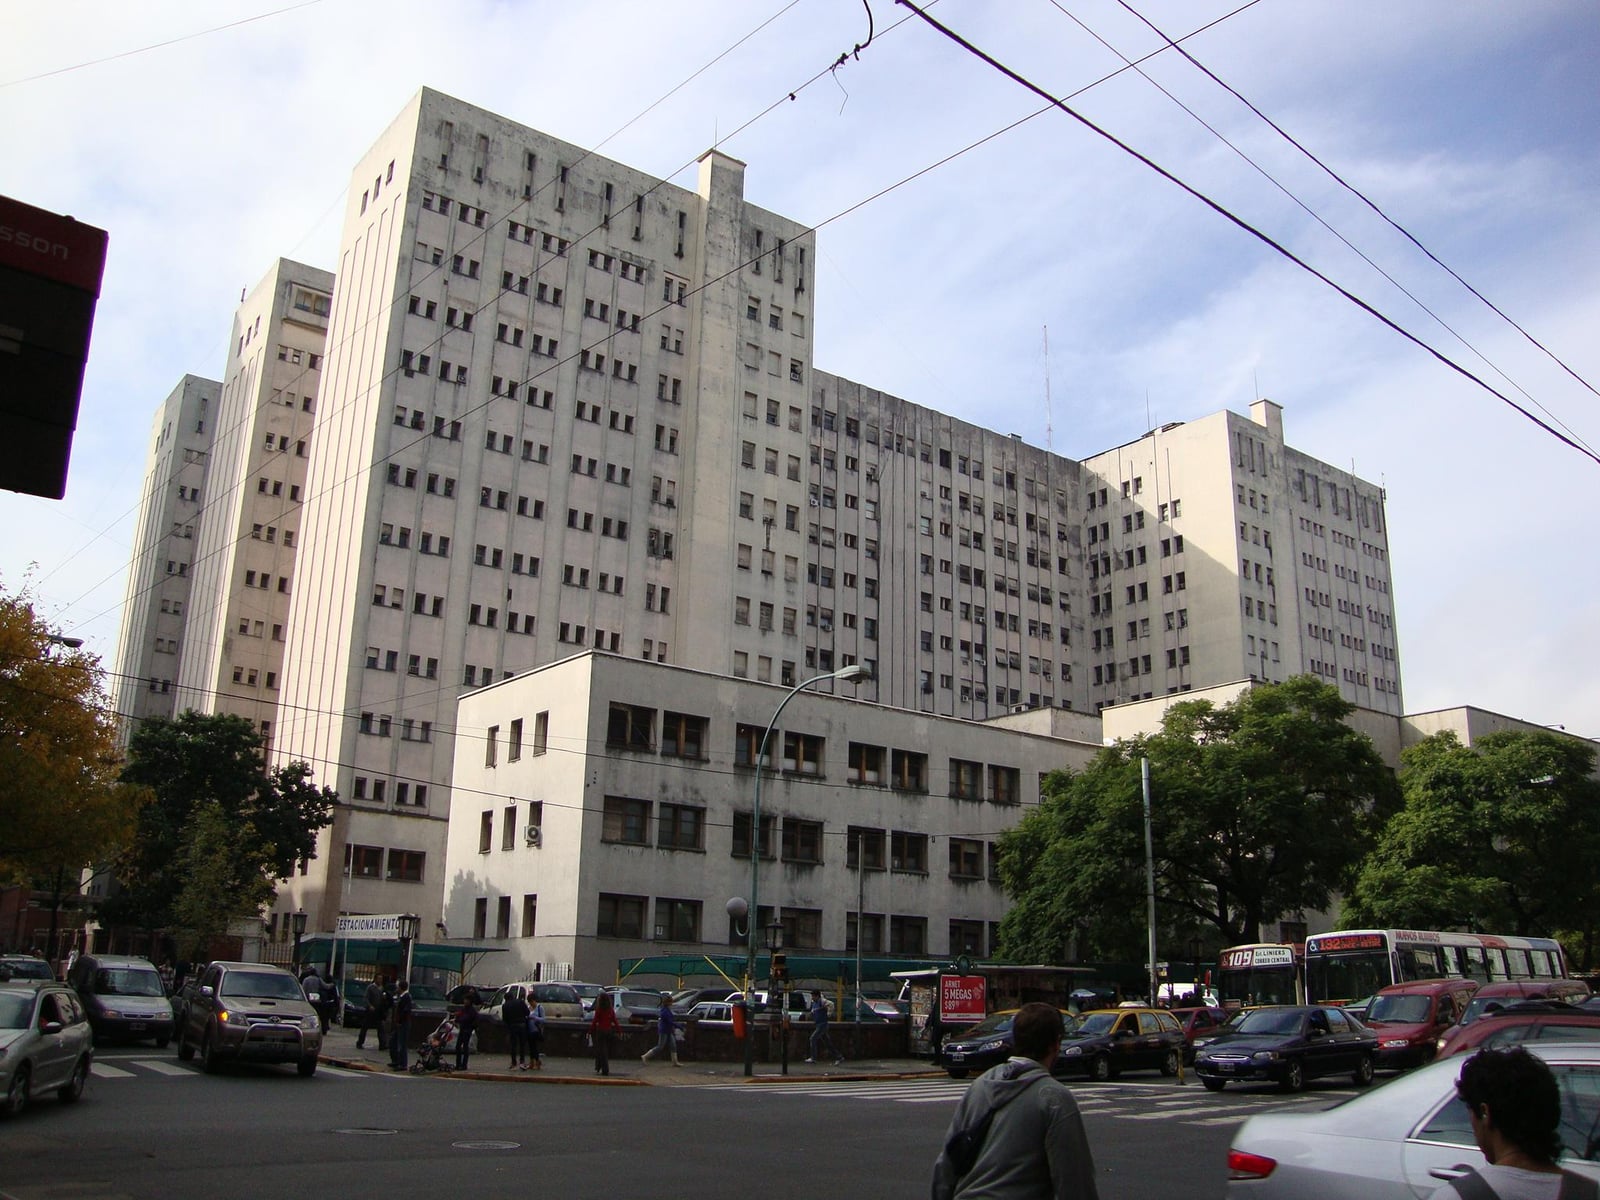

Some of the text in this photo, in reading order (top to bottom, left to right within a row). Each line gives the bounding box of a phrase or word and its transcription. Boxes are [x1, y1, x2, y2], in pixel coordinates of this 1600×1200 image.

[0, 226, 69, 260] sson
[339, 918, 400, 931] ESTACIONAMIENTO
[1229, 951, 1252, 966] 109
[945, 980, 960, 988] ARNET
[944, 989, 972, 1000] 5 MEGAS
